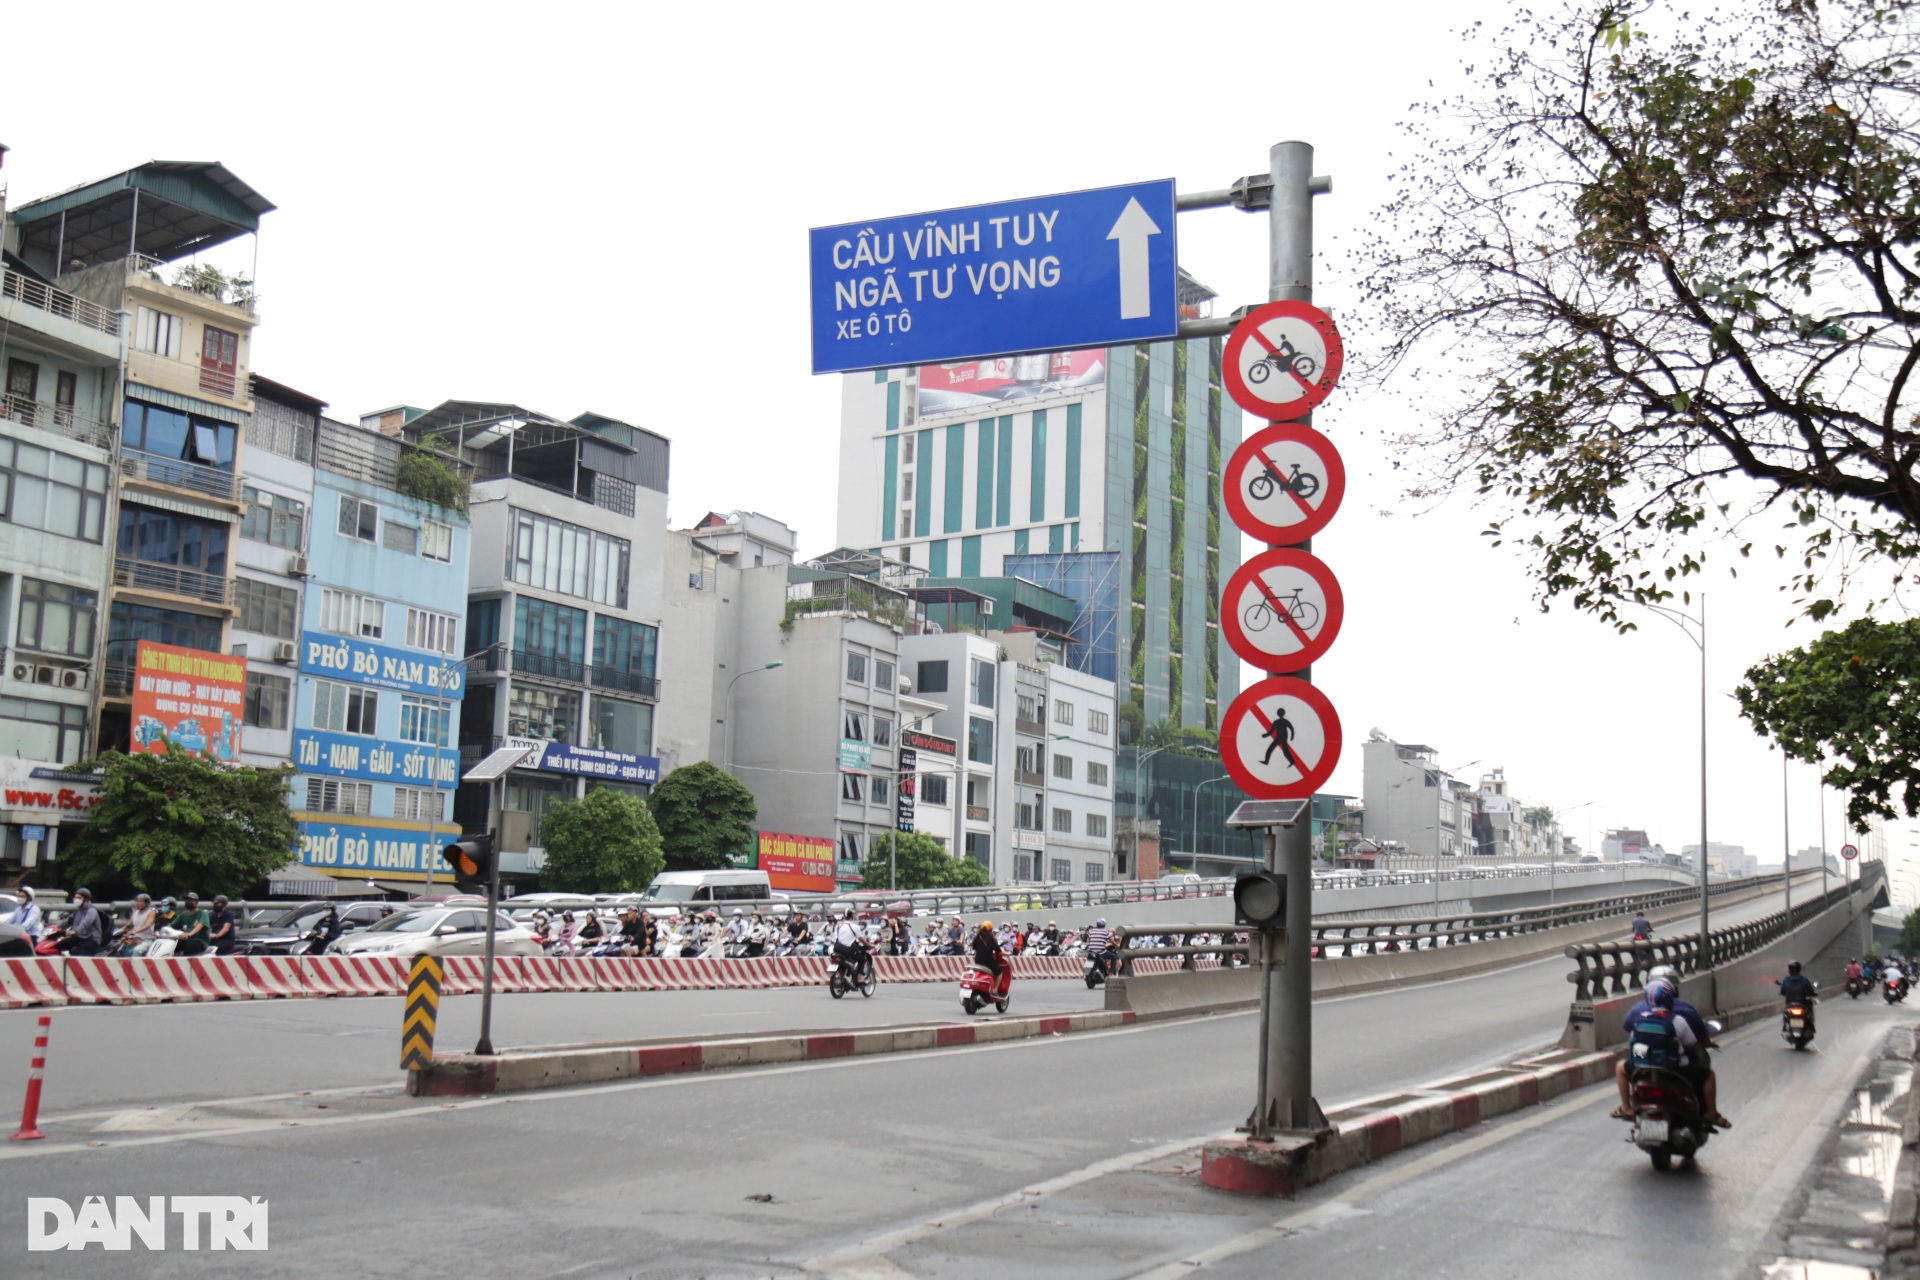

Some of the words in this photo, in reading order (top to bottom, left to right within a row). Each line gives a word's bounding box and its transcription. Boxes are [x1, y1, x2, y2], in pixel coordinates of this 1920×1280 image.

[832, 227, 894, 270] CẦU
[903, 220, 980, 260] VĨNH
[988, 210, 1060, 248] TUY
[834, 269, 903, 311] NGÃ
[908, 263, 957, 302] TƯ
[966, 256, 1061, 299] VỌNG
[836, 318, 862, 340] XE
[867, 312, 880, 336] Ô
[884, 308, 911, 334] TÔ
[308, 640, 350, 670] PHỞ
[353, 648, 379, 675] BÒ
[383, 656, 423, 685] NAM
[140, 675, 155, 693] MÁY
[196, 684, 211, 700] MÁY
[211, 706, 224, 719] TAY
[300, 736, 320, 766] TÁI
[330, 744, 360, 775] NẠM
[370, 743, 394, 775] GẦU
[403, 747, 425, 778] SỐT
[564, 758, 571, 771] BỊ
[571, 758, 579, 772] VỆ
[580, 760, 594, 773] SINH
[594, 762, 606, 774] CAO
[606, 762, 618, 775] CẤP
[622, 766, 637, 779] GẠCH
[645, 768, 656, 781] LÁT
[569, 746, 604, 758] Showroom
[605, 751, 621, 761] Hùng
[622, 753, 636, 763] Phát
[5, 788, 102, 811] www.f5c.v
[299, 828, 339, 864] PHỞ
[343, 832, 369, 866] BÒ
[374, 840, 417, 869] NAM
